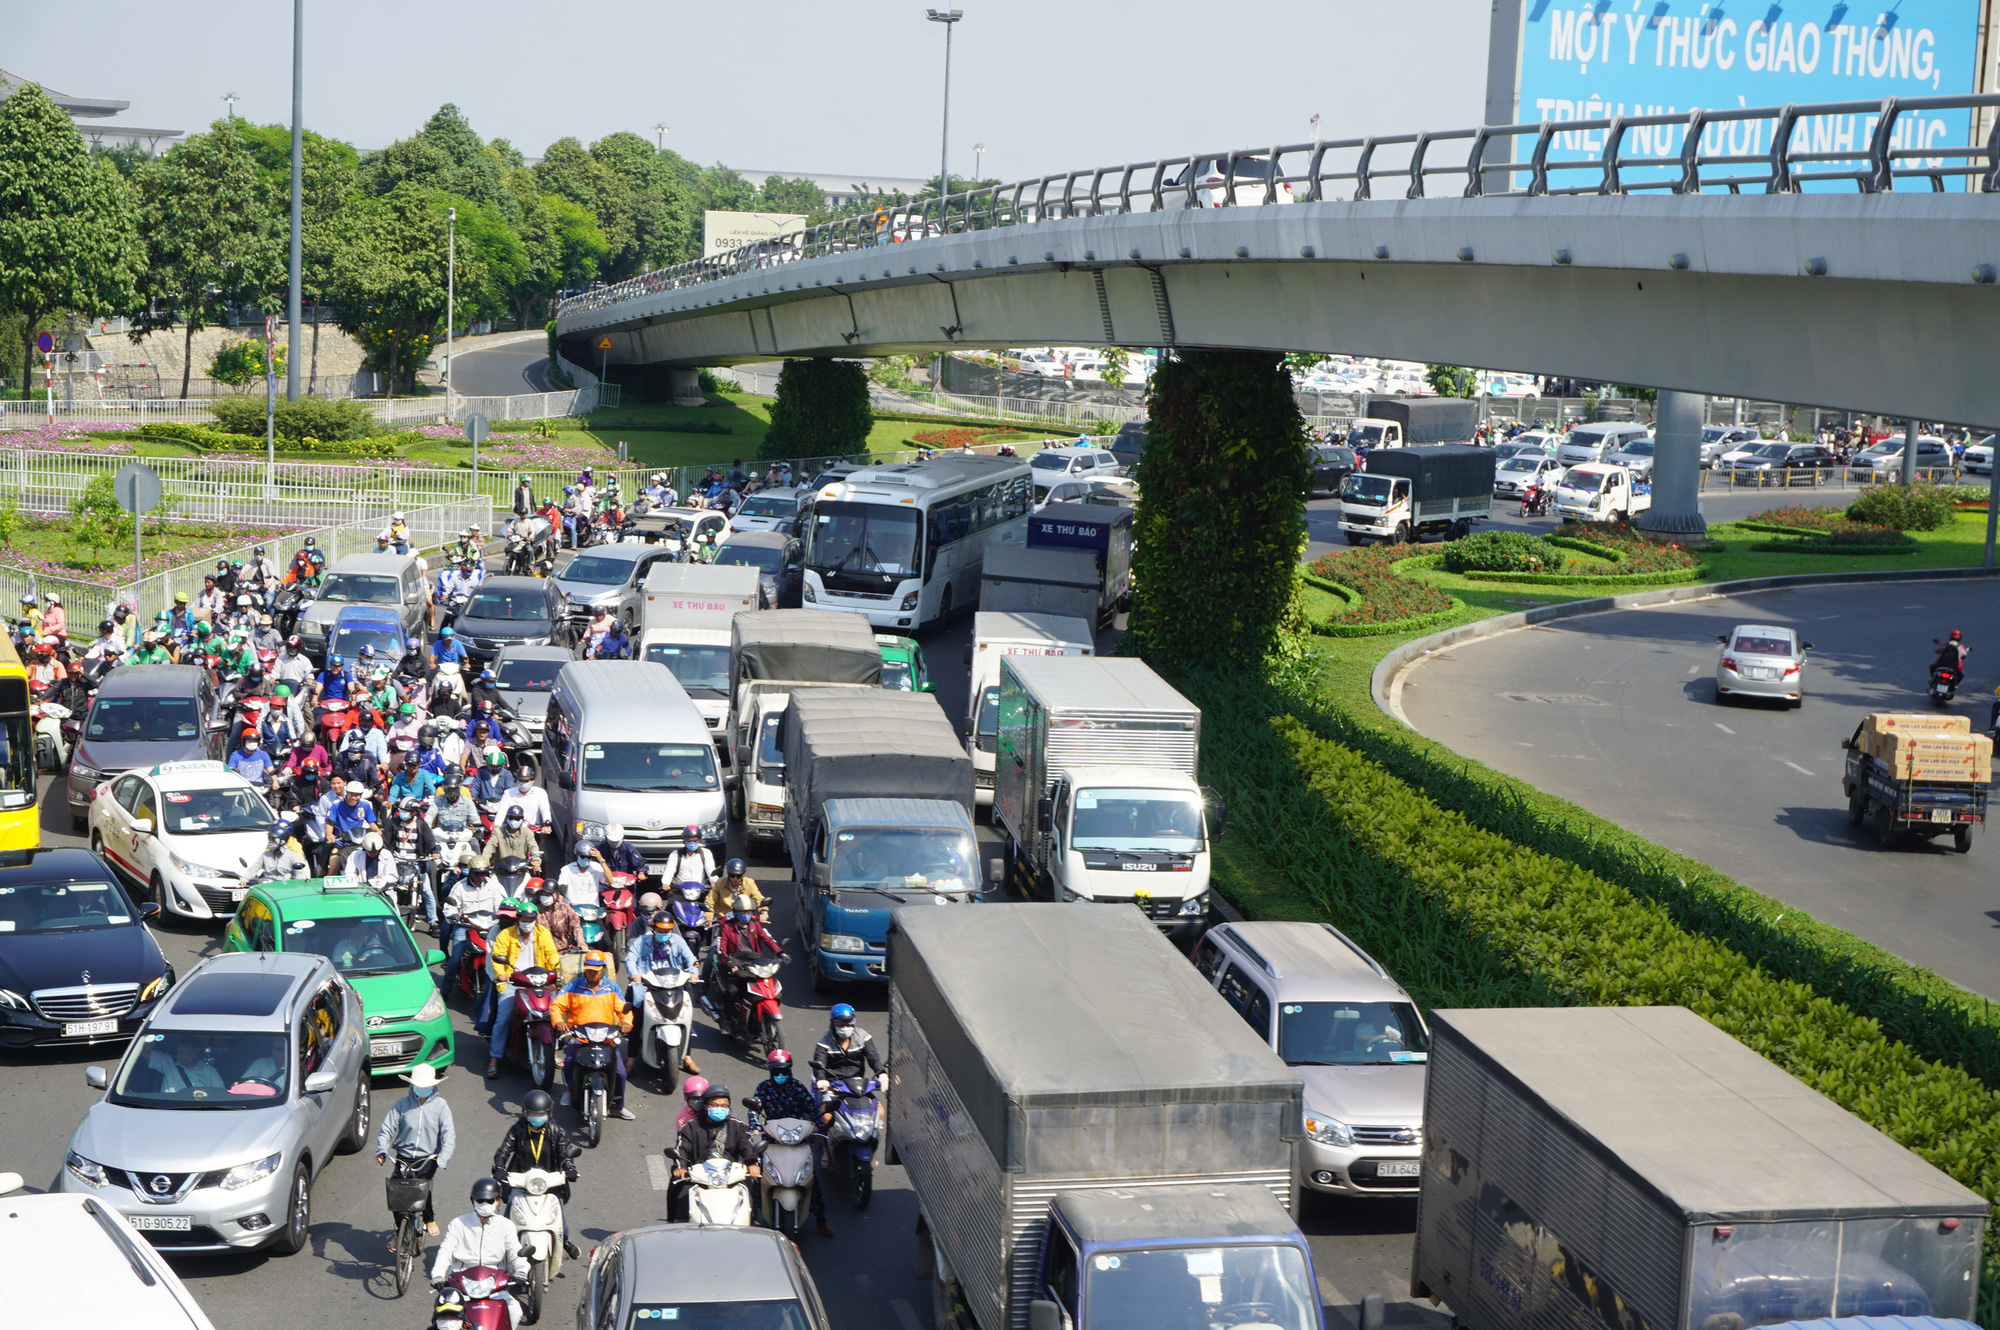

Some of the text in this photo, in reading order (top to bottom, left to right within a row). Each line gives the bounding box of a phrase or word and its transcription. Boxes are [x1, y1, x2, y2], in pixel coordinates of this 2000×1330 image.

[1549, 0, 1940, 90] MỘT Ý THỨC GIAO THÔNG,
[1041, 523, 1097, 537] XE THƯ BÁO
[672, 601, 684, 609] XE
[687, 601, 705, 610] THƯ
[1008, 648, 1019, 656] XE
[1122, 863, 1157, 871] ISUZU
[325, 876, 354, 887] TAXI
[130, 1217, 188, 1229] 51G-905.22
